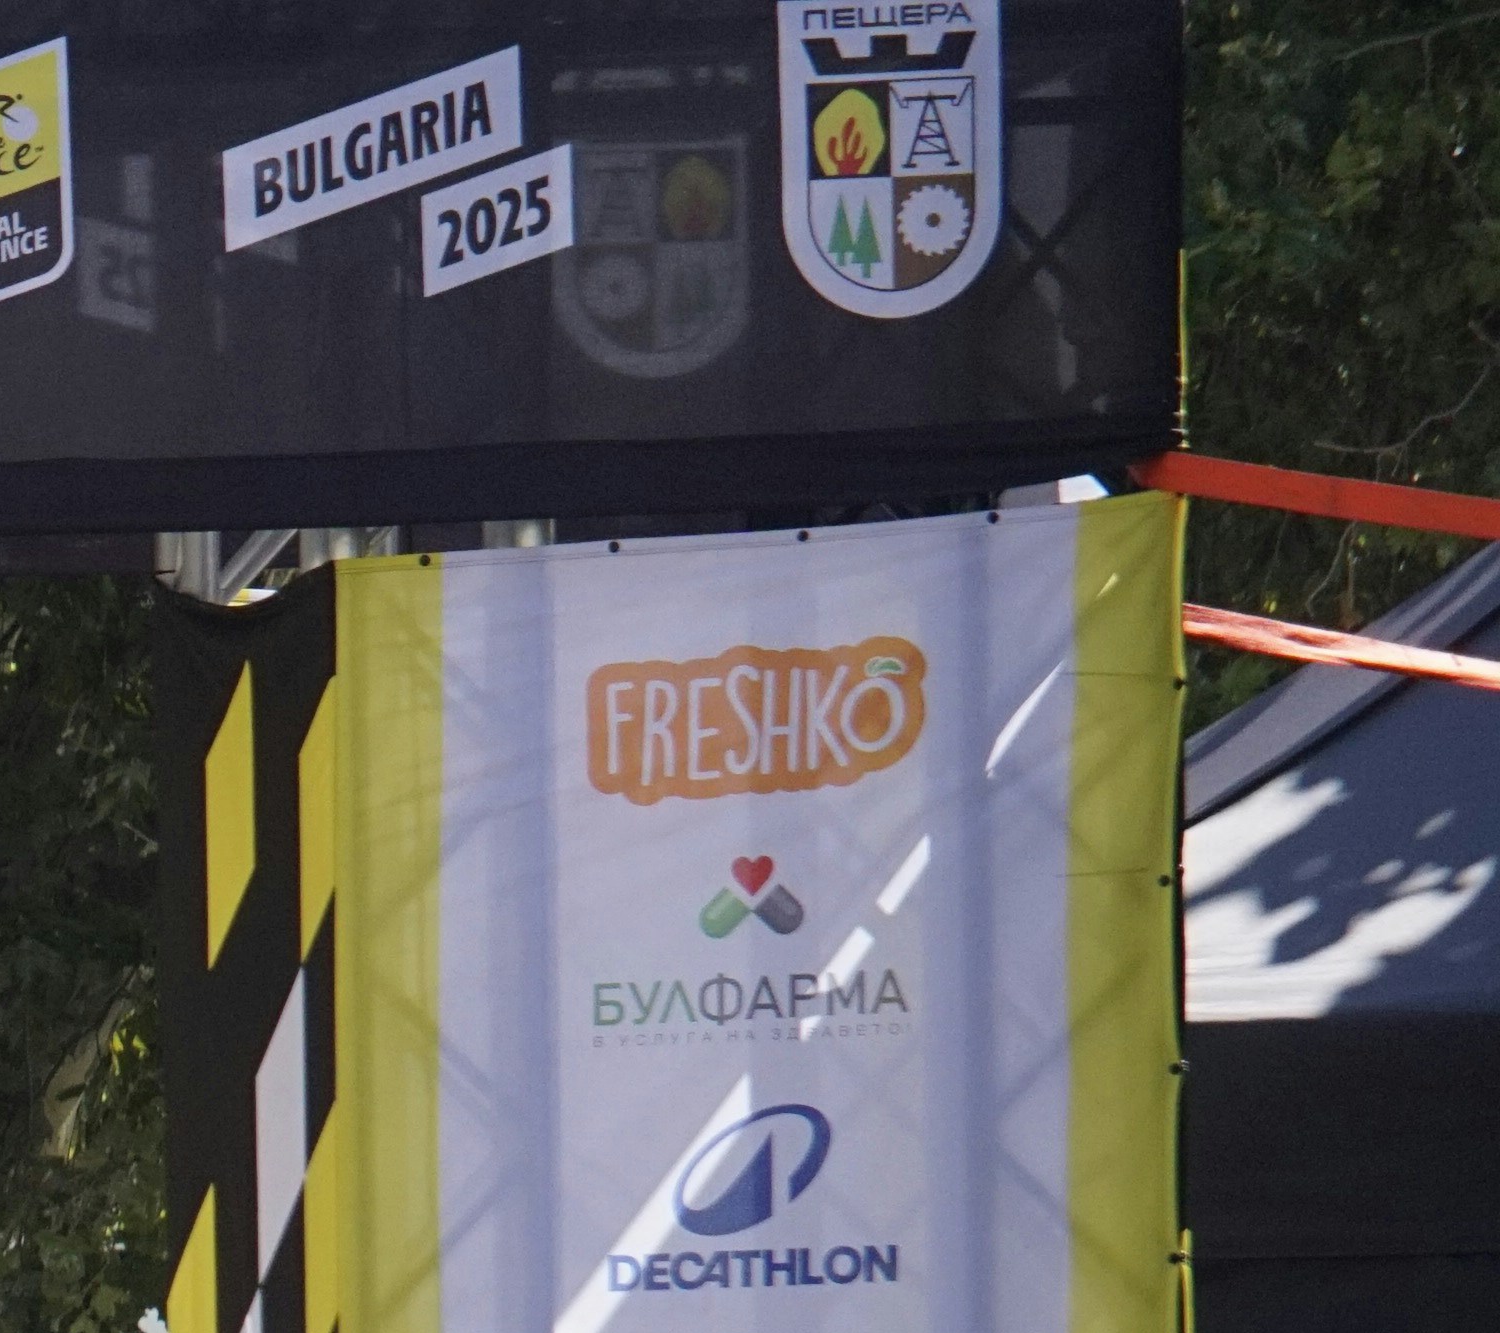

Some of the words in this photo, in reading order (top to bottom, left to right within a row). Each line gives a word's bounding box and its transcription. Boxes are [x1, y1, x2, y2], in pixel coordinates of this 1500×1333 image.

[803, 2, 972, 30] ПЕЩЕРА
[253, 80, 492, 218] BULGARIA
[437, 175, 552, 269] 2025
[606, 658, 906, 787] FRESHKO
[593, 967, 910, 1027] БУЛФАРМА
[606, 1244, 899, 1292] DECATHLON
